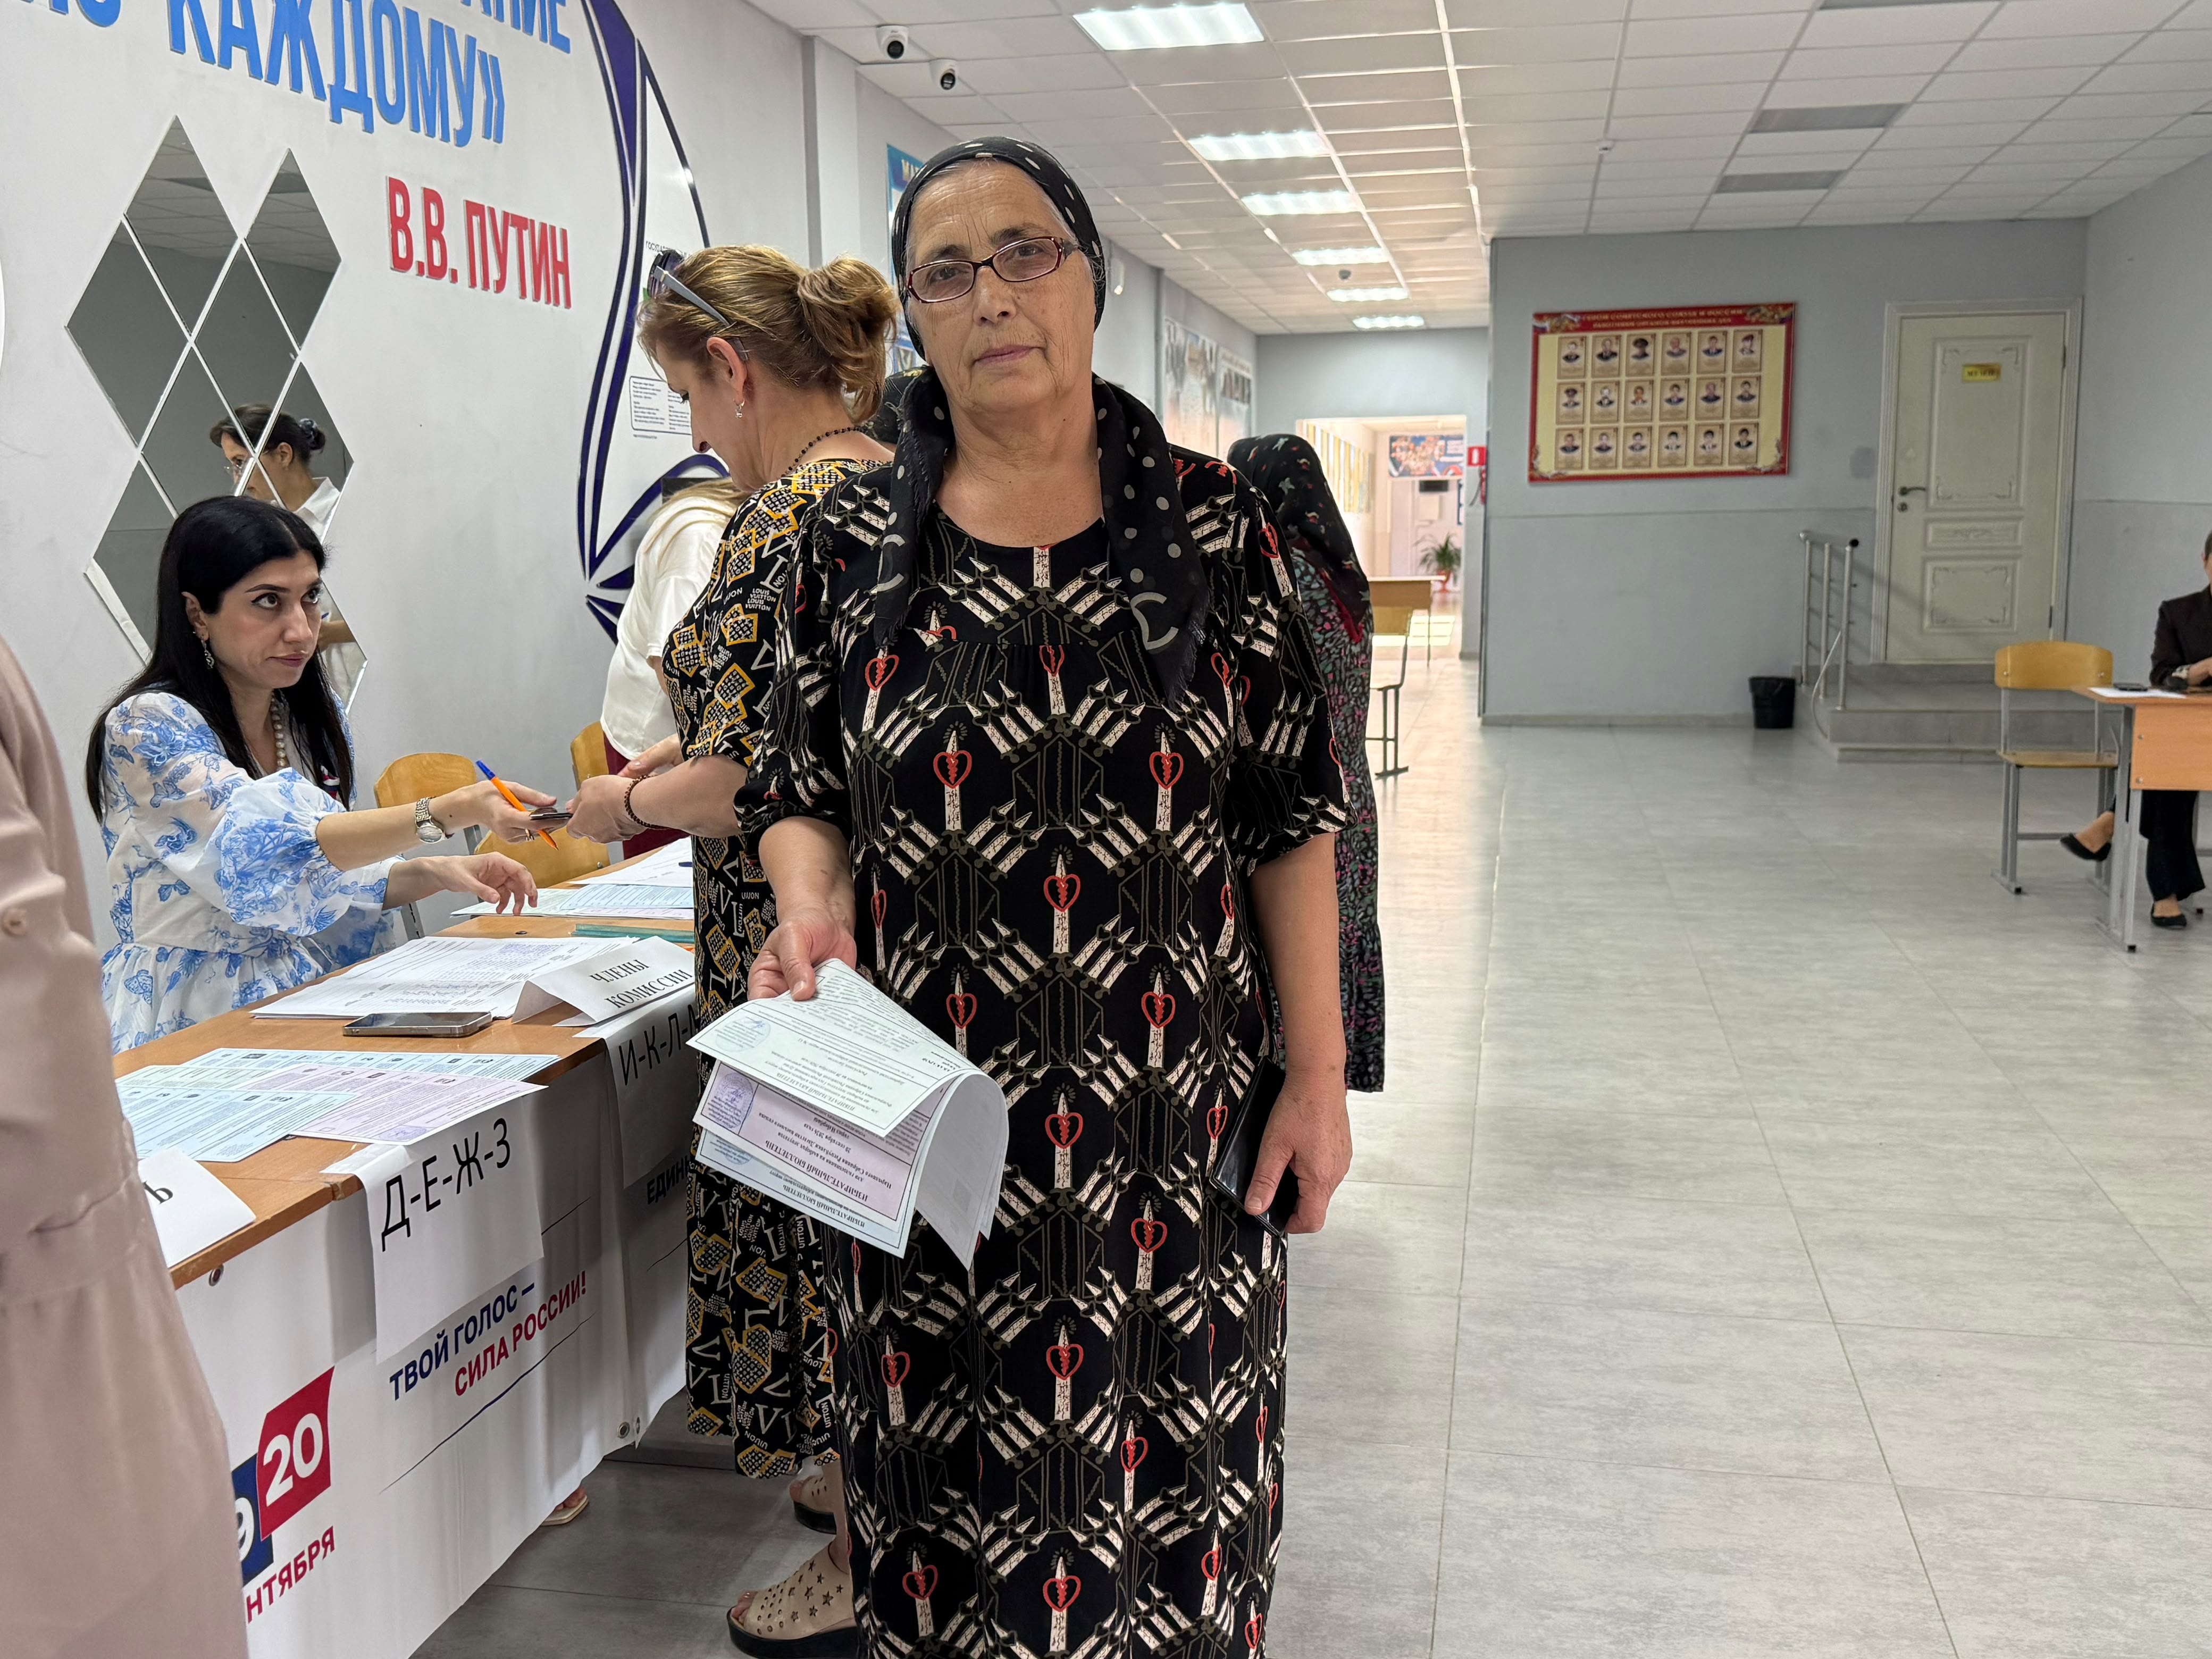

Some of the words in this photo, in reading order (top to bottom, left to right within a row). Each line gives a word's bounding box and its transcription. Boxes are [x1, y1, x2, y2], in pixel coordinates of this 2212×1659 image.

[387, 175, 458, 283] В.В.
[464, 199, 571, 309] ПУТИН
[749, 593, 776, 602] VUITTON
[589, 959, 651, 983] ЧЛЕНЫ
[604, 969, 693, 1008] КОМИССИИ
[381, 1118, 510, 1252] Д-Е-Ж-З
[763, 1139, 807, 1168] БЮЛЛЕТЕНЬ
[804, 1162, 869, 1203] ИЗБИРАТЕЛЬНЫЙ
[389, 1329, 450, 1401] ТВОЙ
[454, 1284, 517, 1355] ГОЛОС
[454, 1335, 509, 1396] СИЛА
[512, 1270, 586, 1352] РОССИИ!
[263, 1413, 323, 1507] 20
[246, 1525, 336, 1624] НТЯБРЯ
